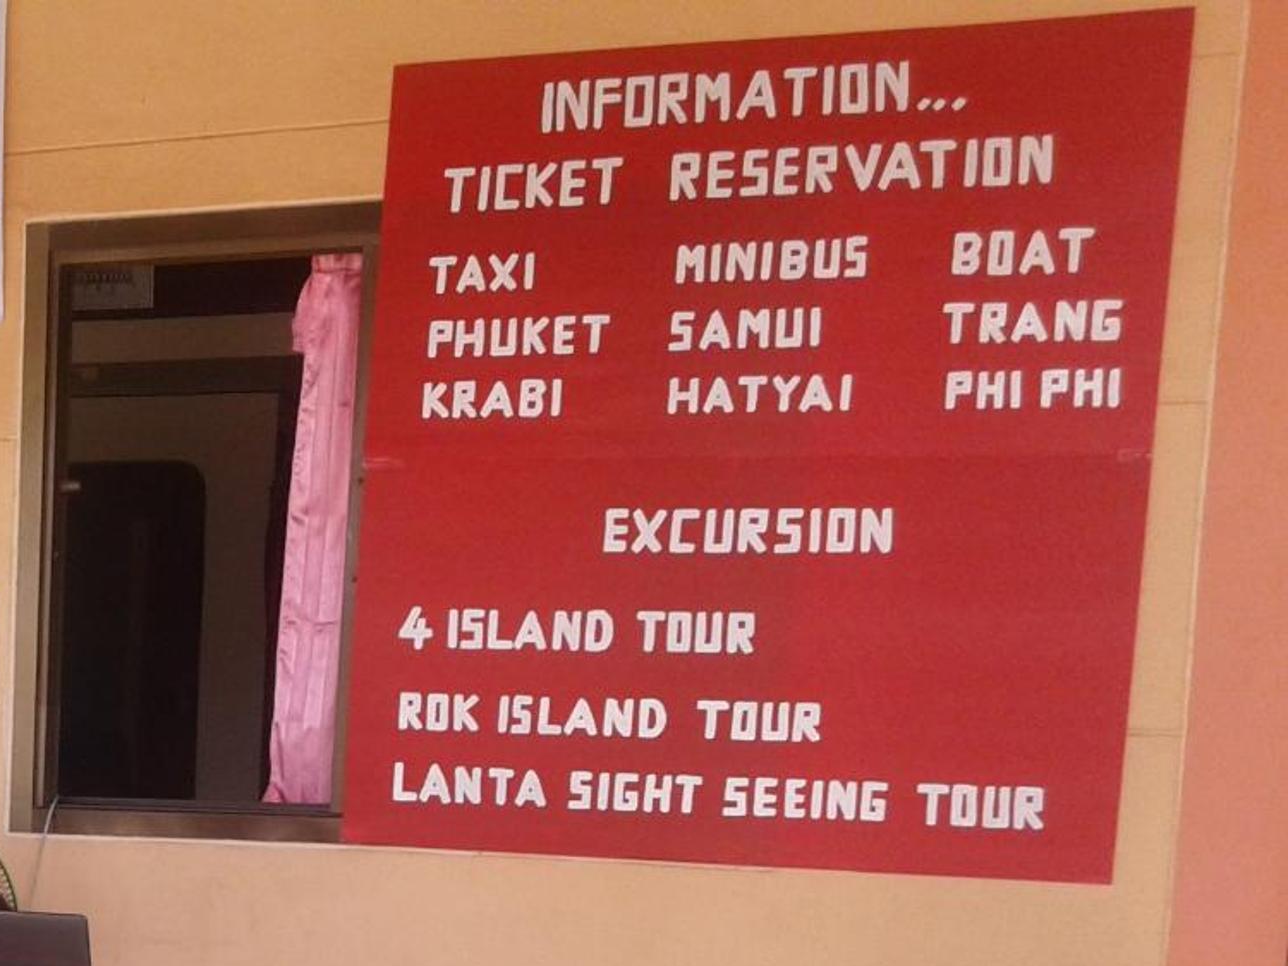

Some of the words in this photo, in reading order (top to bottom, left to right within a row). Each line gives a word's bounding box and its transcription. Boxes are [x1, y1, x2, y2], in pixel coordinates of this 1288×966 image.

[541, 61, 966, 133] INFORMATION...
[444, 157, 624, 213] TICKET
[669, 134, 1054, 201] RESERVATION
[429, 252, 535, 295] TAXI
[675, 235, 868, 284] MINIBUS
[951, 227, 1096, 276] BOAT
[427, 314, 611, 359] PHUKET
[668, 306, 822, 352] SAMUI
[942, 298, 1124, 344] TRANG
[421, 378, 563, 419] KRABI
[667, 374, 853, 415] HATYAI
[944, 370, 1022, 410] PHI
[1039, 367, 1122, 409] PHI
[602, 507, 894, 554] EXCURSION
[398, 605, 433, 651] 4
[447, 608, 614, 653] ISLAND
[636, 610, 756, 655] TOUR
[397, 691, 480, 732] ROK
[497, 694, 668, 739] ISLAND
[696, 699, 822, 743] TOUR
[392, 761, 547, 808] LANTA
[567, 770, 704, 814] SIGHT
[721, 776, 889, 822] SEEING
[916, 782, 1045, 831] TOUR
